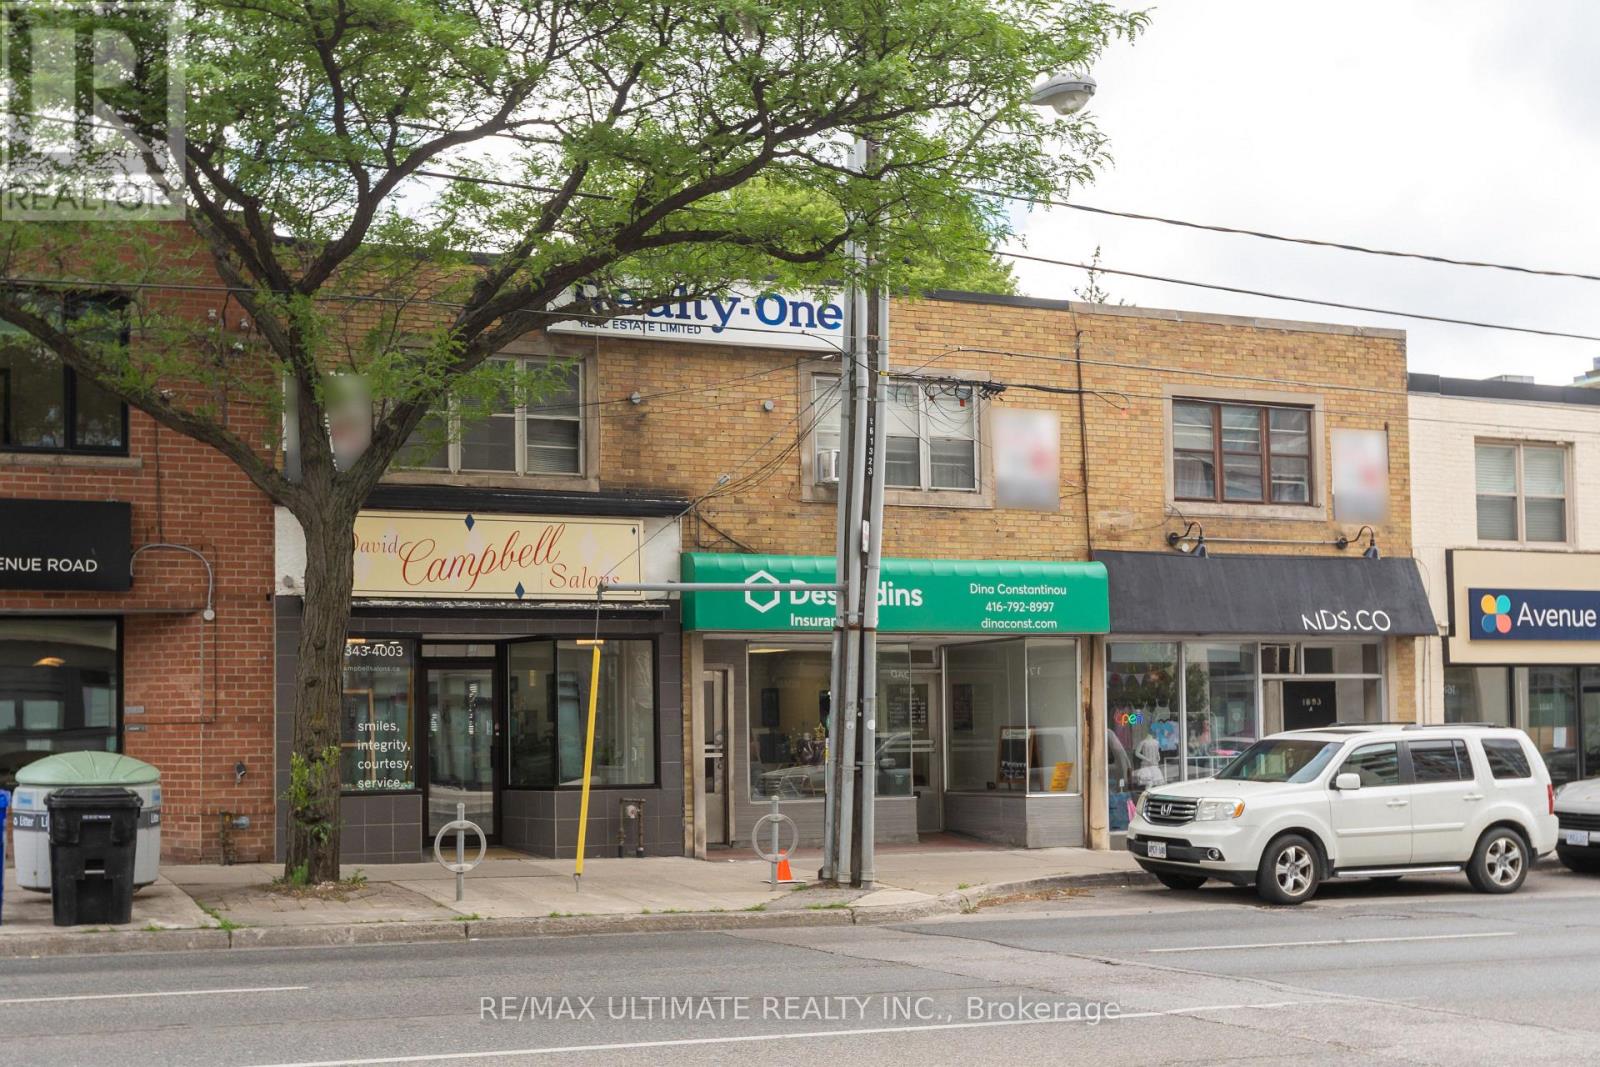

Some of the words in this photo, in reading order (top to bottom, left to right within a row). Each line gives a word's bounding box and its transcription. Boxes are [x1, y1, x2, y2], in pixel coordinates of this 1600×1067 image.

[612, 319, 655, 332] ESTATE
[659, 322, 702, 335] LIMITED
[399, 522, 565, 591] Campbell
[47, 558, 98, 573] ROAD
[549, 563, 620, 589] Salons
[789, 579, 923, 607] Desdins
[969, 583, 995, 594] Dina
[997, 584, 1067, 596] Constantinou
[985, 602, 1055, 613] 416-792-8997
[1516, 602, 1597, 628] Avenue
[981, 618, 1058, 629] dinaconst.com
[357, 720, 400, 733] smiles,
[19, 817, 34, 828] Litter
